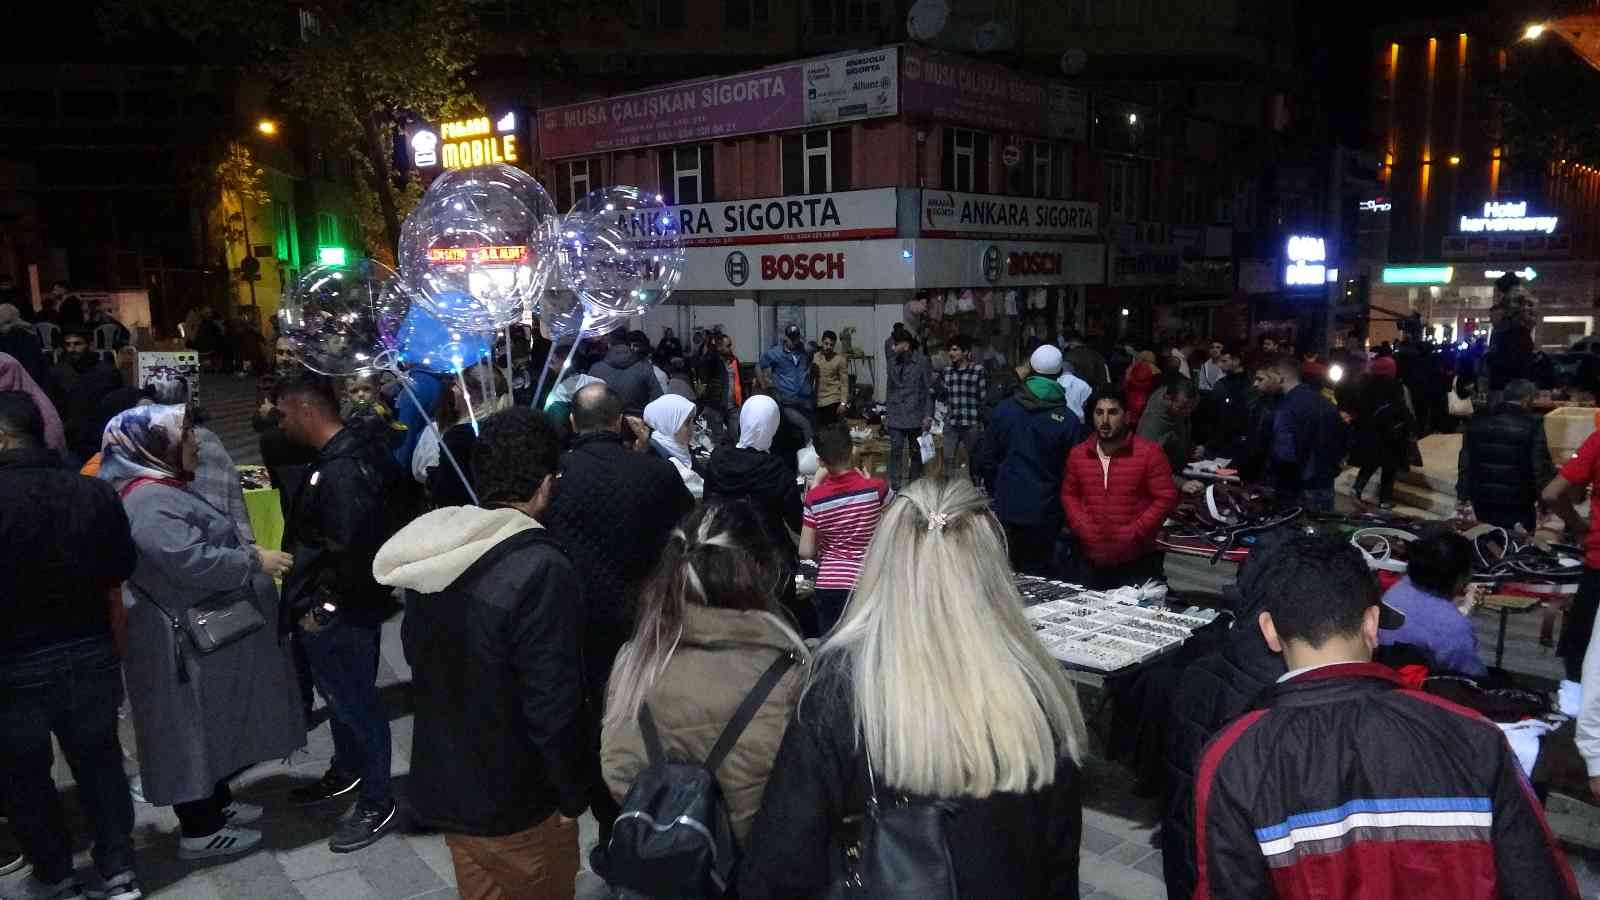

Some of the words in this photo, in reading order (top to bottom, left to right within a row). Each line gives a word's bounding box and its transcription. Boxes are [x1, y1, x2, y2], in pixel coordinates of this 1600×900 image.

[564, 106, 607, 129] MUSA
[612, 90, 696, 125] ÇALIŞKAN
[617, 206, 713, 238] ANKARA
[960, 200, 1030, 226] ANKARA
[761, 252, 845, 281] BOSCH
[1007, 251, 1063, 276] BOSCH
